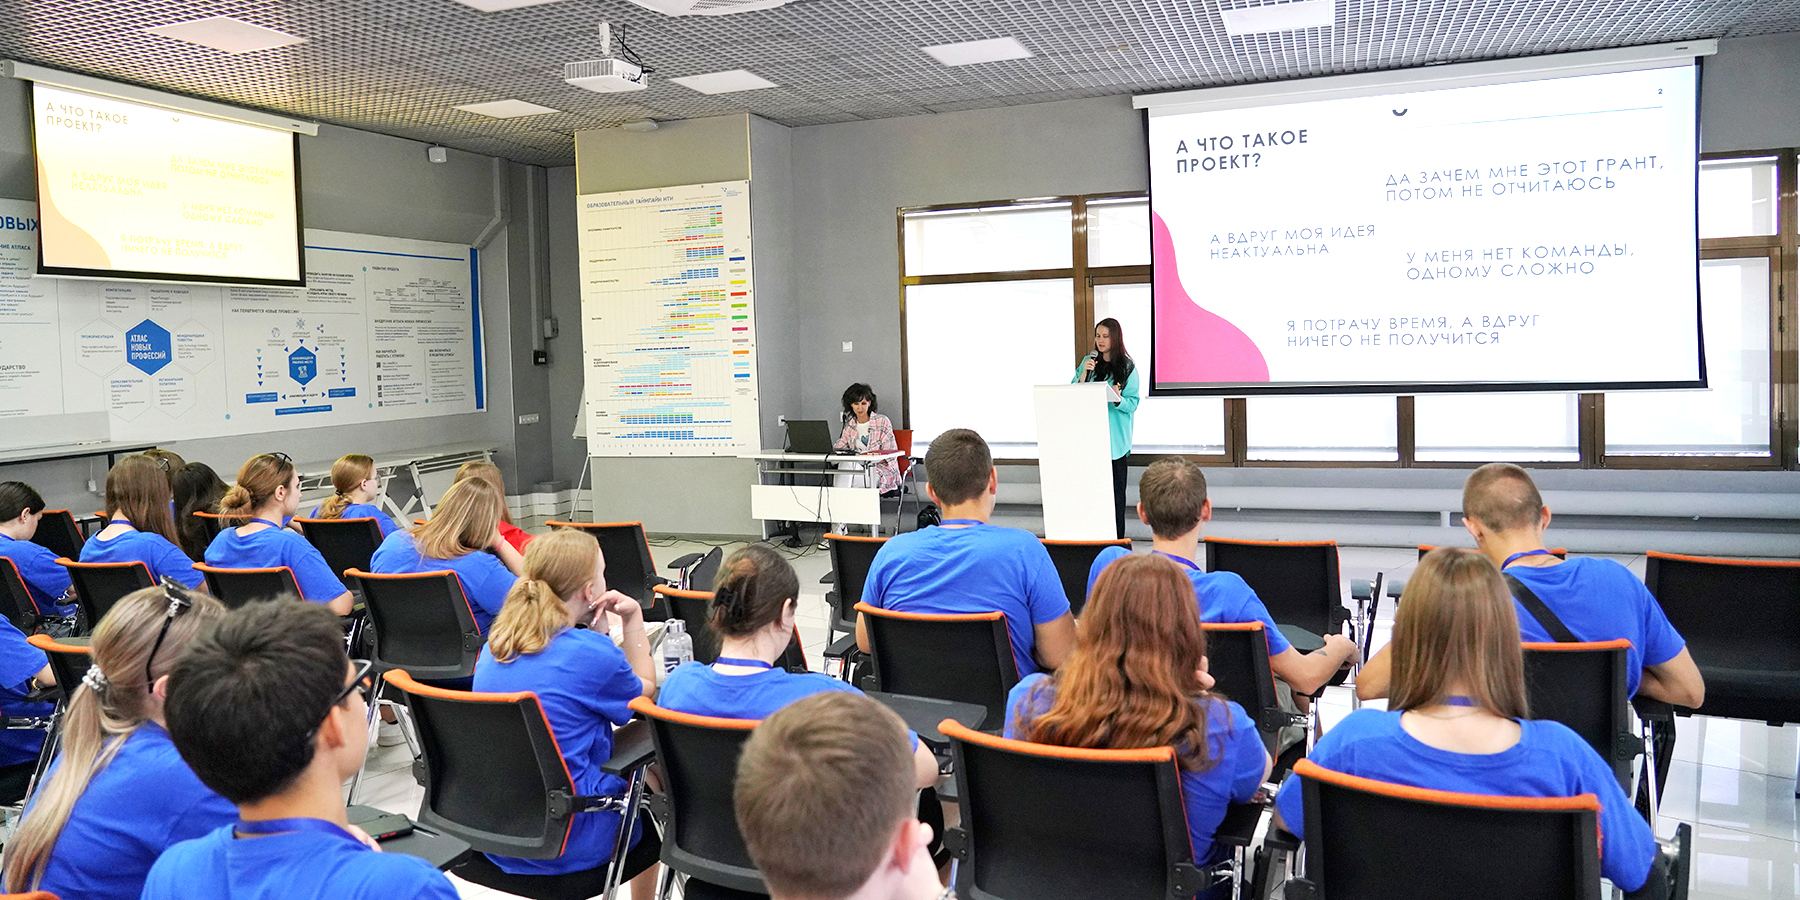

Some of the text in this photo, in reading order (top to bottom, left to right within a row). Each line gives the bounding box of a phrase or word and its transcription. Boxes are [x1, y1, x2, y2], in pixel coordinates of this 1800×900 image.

[46, 102, 128, 125] А ЧТО ТАКОЕ
[46, 115, 102, 133] ПРОЕКТ?
[1176, 129, 1308, 154] А ЧТО ТАКОЕ
[1177, 153, 1262, 173] ПРОЕКТ?
[1385, 156, 1664, 187] ДА ЗАЧЕМ МНЕ ЭТОТ ГРАНТ,
[71, 171, 167, 190] А ВДРУГ МОЯ ИДЕЯ
[71, 181, 143, 196] НЕАКТУАЛЬНА
[1386, 177, 1615, 201] ПОТОМ НЕ ОТЧИТАЮСЬ
[587, 198, 634, 208] ОБРАЗОВАТЕЛЬНЫЙ
[1210, 225, 1375, 244] А ВДРУГ МОЯ ИДЕЯ
[1210, 244, 1329, 259] НЕАКТУАЛЬНА
[1406, 243, 1634, 264] У МЕНЯ НЕТ КОМАНДЫ,
[1407, 261, 1594, 280] ОДНОМУ СЛОЖНО
[1287, 315, 1539, 331] Я ПОТРАЧУ ВРЕМЯ, А ВДРУГ
[130, 334, 148, 343] АТЛАС
[131, 343, 151, 351] НОВЫХ
[1287, 332, 1499, 346] НИЧЕГО НЕ ПОЛУЧИТСЯ
[131, 351, 166, 360] ПРОФЕССИЙ
